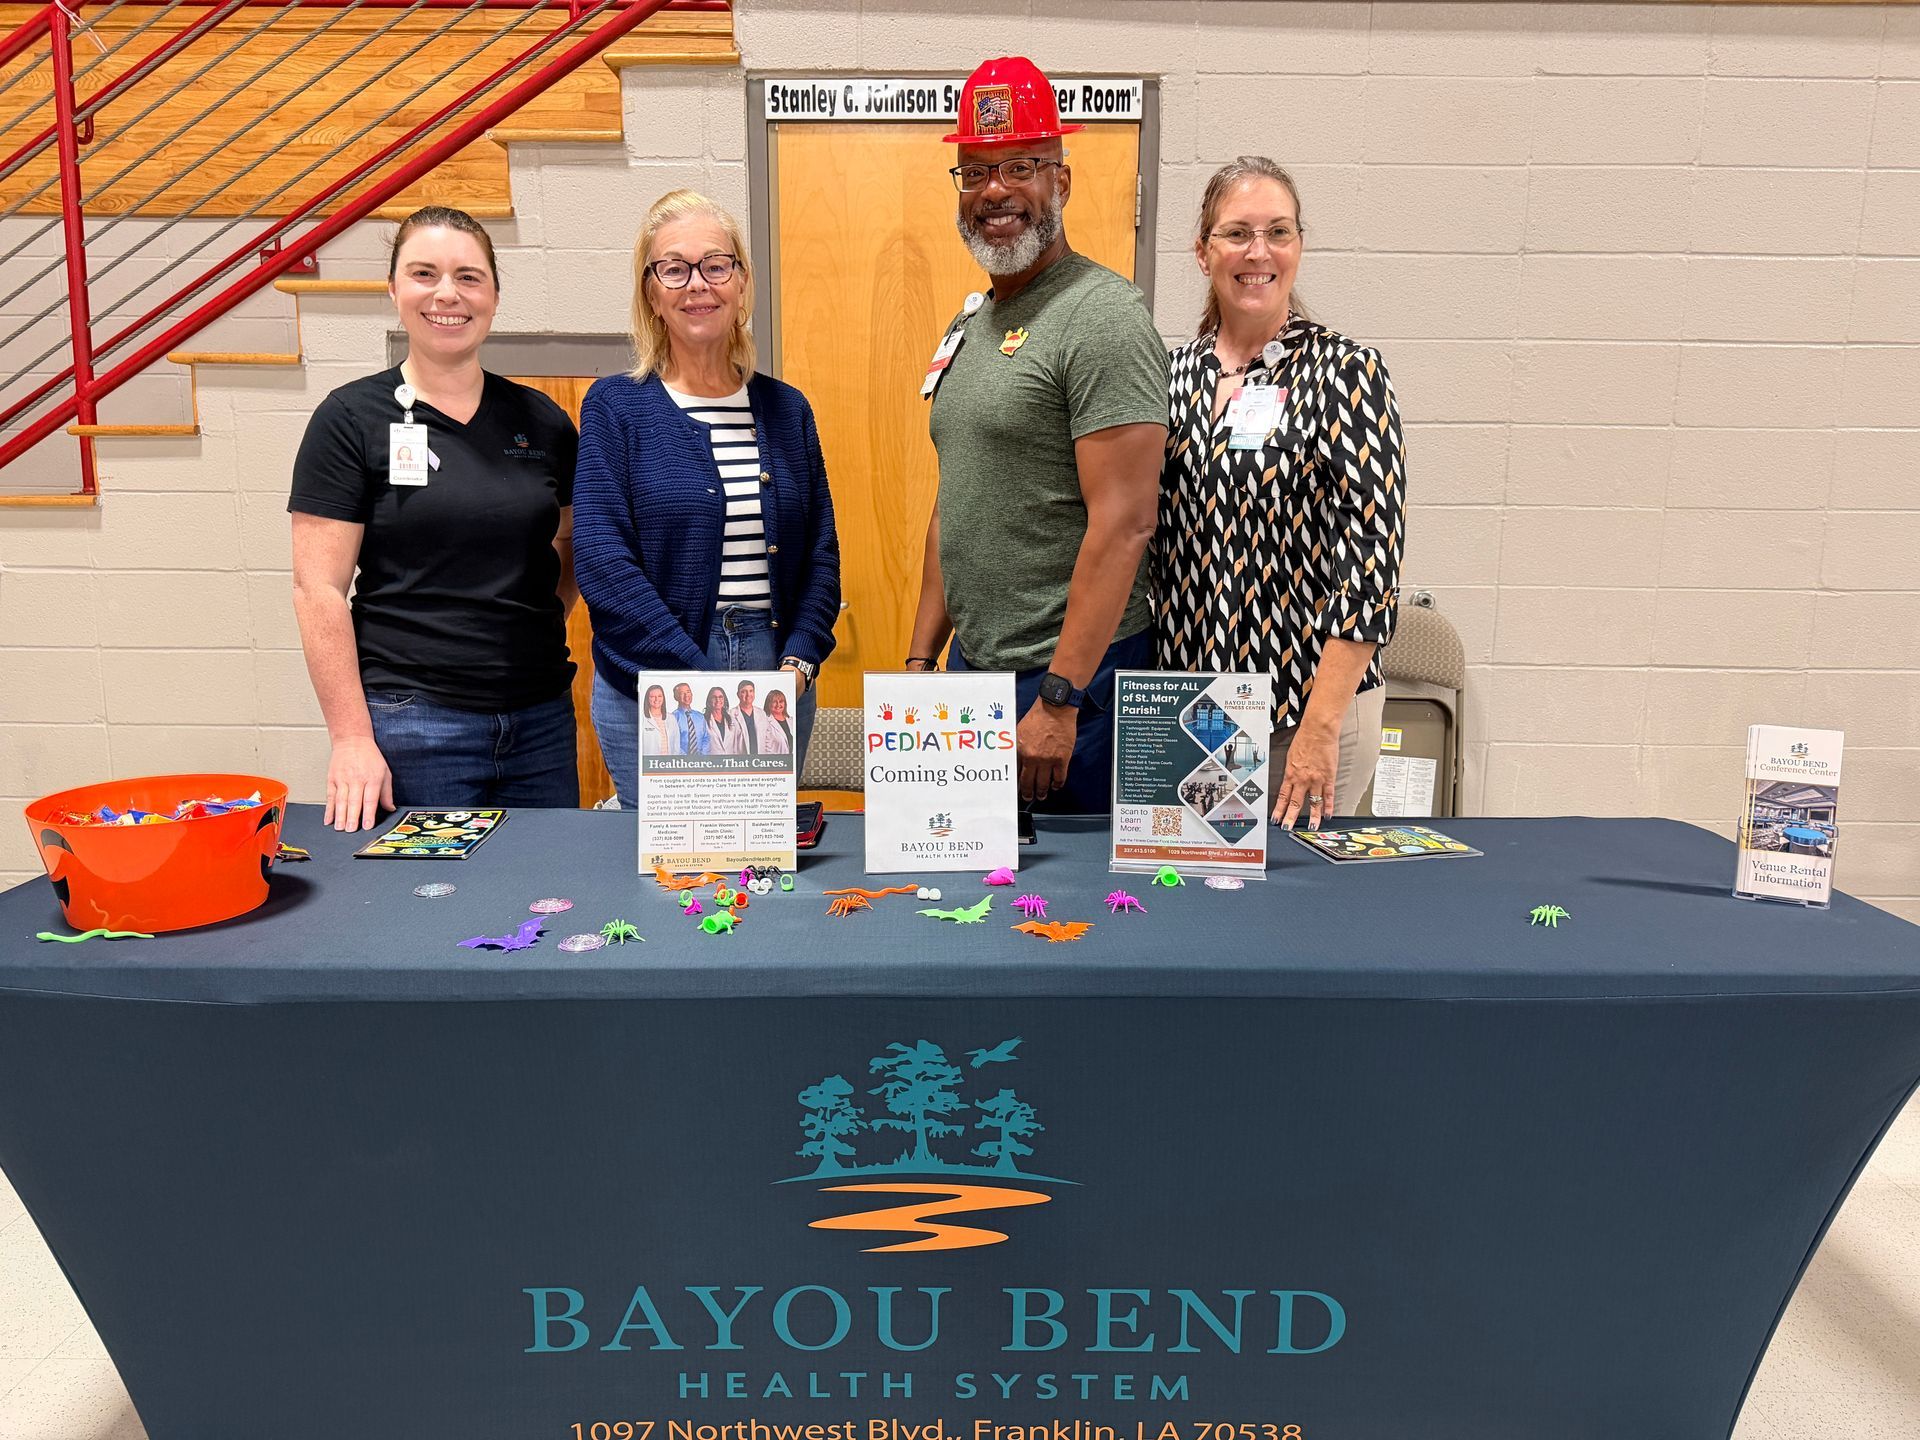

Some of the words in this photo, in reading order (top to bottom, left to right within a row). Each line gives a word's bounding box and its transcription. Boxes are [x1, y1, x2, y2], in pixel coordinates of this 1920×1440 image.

[771, 84, 836, 117] Stanley
[844, 85, 858, 113] G.
[866, 83, 936, 113] Johnson
[1122, 681, 1162, 691] Fitness
[1163, 681, 1179, 691] for
[1181, 682, 1199, 691] ALL
[1122, 693, 1134, 703] of
[1135, 693, 1148, 703] St.
[1151, 694, 1179, 706] Mary
[1122, 705, 1160, 715] Parish!
[868, 730, 1014, 753] PEDIATRICS
[752, 758, 788, 768] Cares.
[1771, 757, 1800, 766] BAYOU
[1803, 760, 1828, 769] BEND
[870, 764, 948, 786] Coming
[954, 764, 1009, 782] Soon!
[1760, 763, 1806, 774] Conference
[1809, 768, 1838, 777] Center
[1120, 807, 1138, 815] Scan
[1140, 808, 1148, 816] to
[1120, 816, 1141, 824] Learn
[1120, 825, 1141, 833] More:
[901, 841, 944, 852] BAYOU
[949, 841, 984, 851] BEND
[1752, 860, 1786, 873] Venue
[1790, 863, 1827, 878] Rental
[1754, 872, 1822, 889] Information
[522, 1285, 952, 1353] BAYOU
[1000, 1287, 1347, 1355] BEND
[678, 1372, 912, 1399] HEALTH
[954, 1373, 1189, 1401] SYSTEM
[570, 1421, 654, 1440] 1097
[668, 1418, 856, 1440] Northwest
[1138, 1421, 1180, 1440] LA
[1193, 1422, 1302, 1440] 70538
